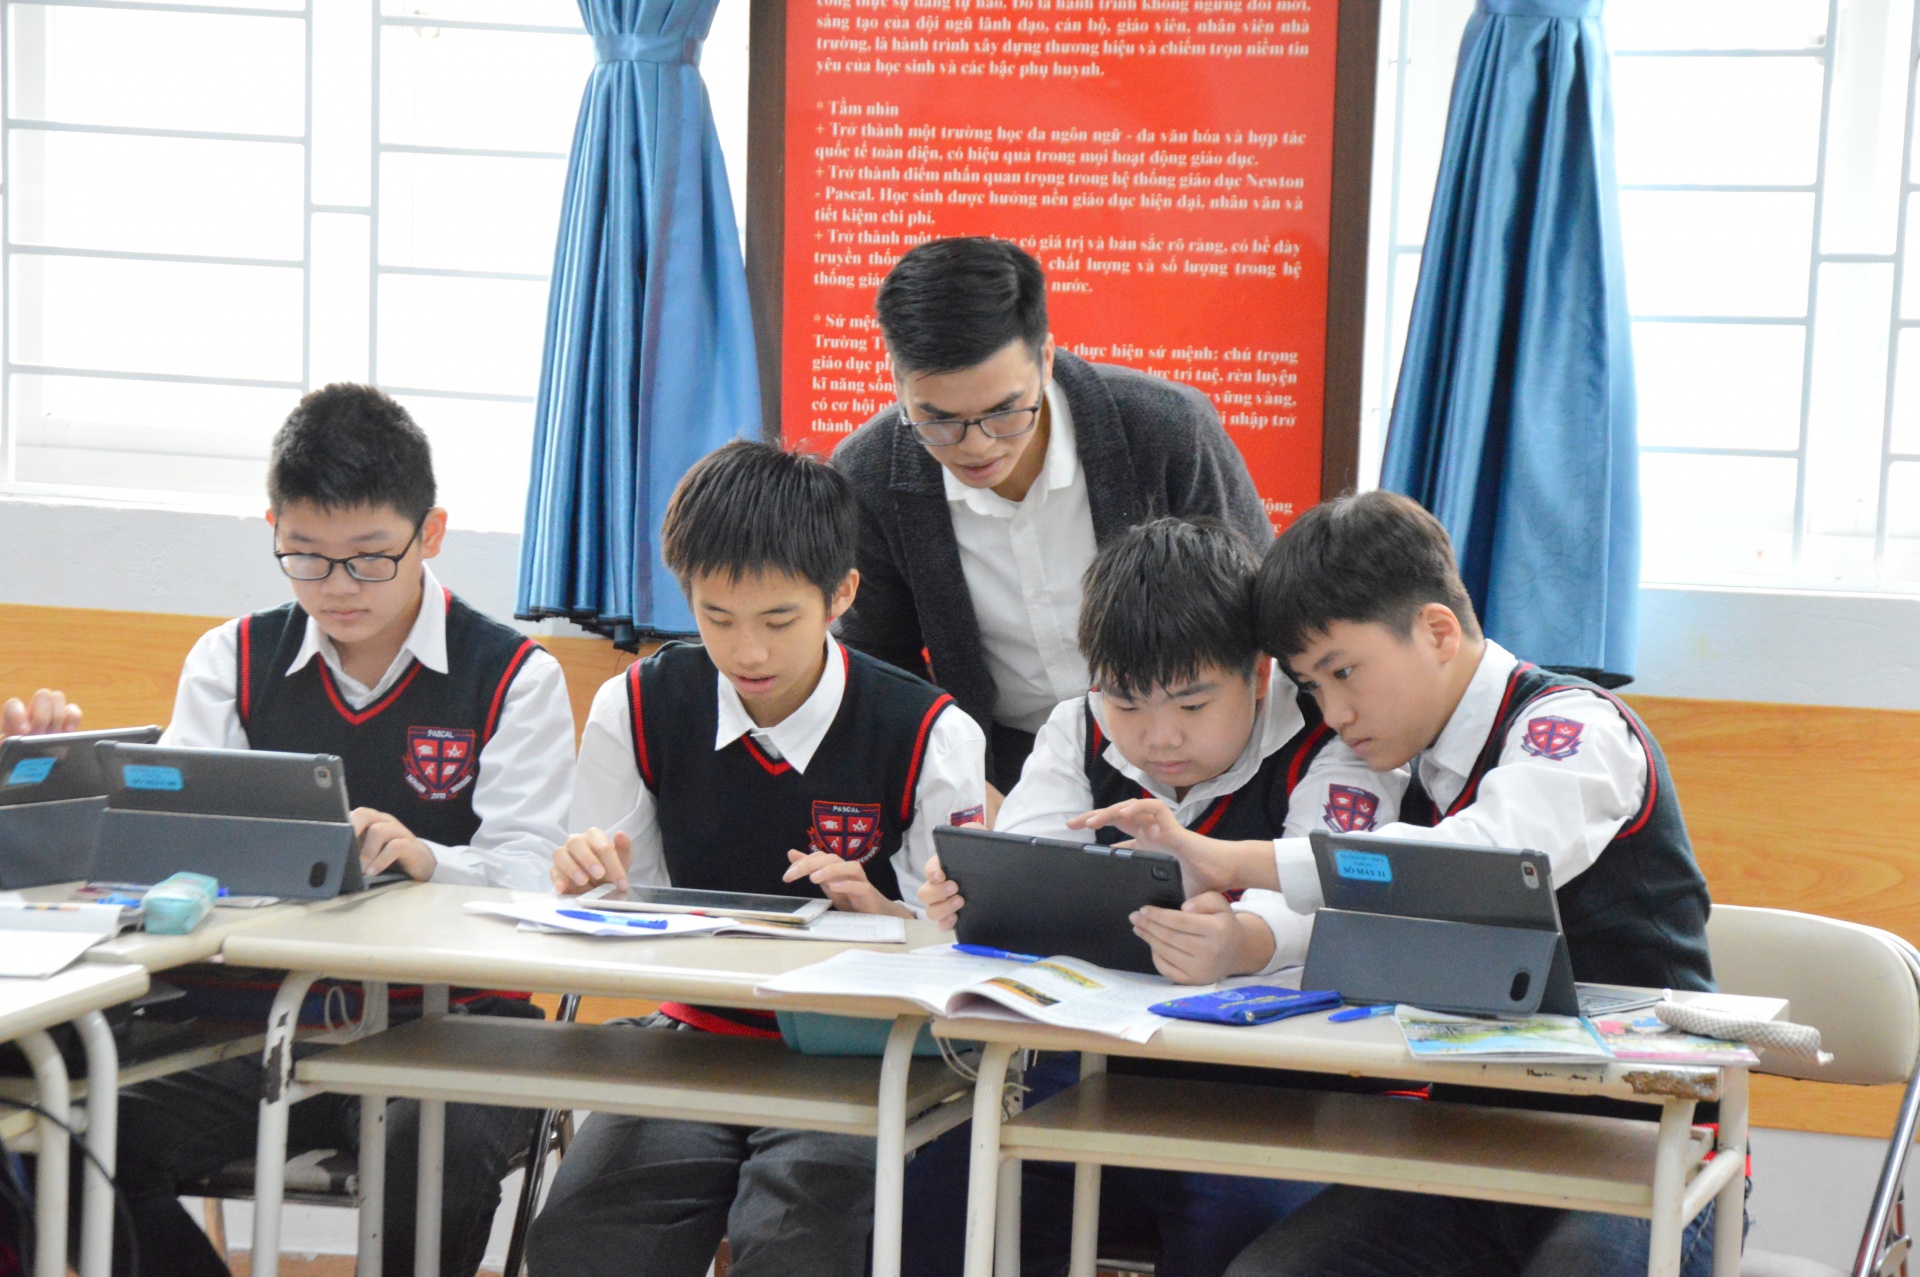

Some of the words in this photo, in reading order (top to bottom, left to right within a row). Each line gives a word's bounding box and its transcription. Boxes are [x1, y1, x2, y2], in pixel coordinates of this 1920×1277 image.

[816, 14, 850, 33] sáng
[856, 16, 879, 33] tạo
[916, 15, 939, 34] đội
[944, 15, 974, 35] ngũ
[978, 16, 1012, 31] lãnh
[1017, 16, 1050, 35] đạo,
[1054, 16, 1082, 32] cán
[1088, 17, 1110, 36] bộ,
[1116, 17, 1148, 36] giáo
[1154, 17, 1190, 35] viên,
[1196, 18, 1236, 33] nhân
[1242, 18, 1274, 34] viên
[1280, 19, 1310, 34] nhà
[816, 36, 872, 56] trường,
[874, 36, 888, 52] là
[892, 37, 928, 52] hành
[932, 37, 970, 53] trình
[974, 38, 998, 57] xây
[1002, 38, 1042, 57] dựng
[1045, 38, 1100, 58] thương
[1102, 39, 1134, 58] hiệu
[1138, 39, 1156, 55] và
[1160, 36, 1206, 55] chiếm
[1209, 41, 1242, 59] trọn
[1246, 37, 1284, 56] niềm
[1287, 42, 1308, 56] tin
[816, 57, 841, 76] yêu
[875, 58, 901, 77] học
[904, 58, 934, 74] sinh
[938, 59, 957, 74] và
[960, 59, 986, 75] các
[989, 60, 1014, 79] bậc
[1018, 60, 1048, 79] phụ
[1052, 61, 1104, 80] huynh.
[828, 97, 862, 116] Tầm
[861, 122, 904, 138] thành
[908, 123, 936, 142] một
[940, 123, 992, 143] trường
[997, 124, 1022, 143] học
[1050, 125, 1088, 144] ngôn
[1092, 126, 1122, 145] ngữ
[1160, 127, 1188, 142] văn
[1192, 127, 1220, 143] hóa
[1226, 128, 1242, 143] và
[1248, 128, 1278, 148] hợp
[1282, 129, 1306, 144] tác
[814, 140, 850, 163] quốc
[854, 140, 868, 159] tế
[872, 144, 904, 160] toàn
[906, 145, 944, 164] diện,
[947, 145, 964, 161] có
[968, 146, 999, 165] hiệu
[1036, 148, 1076, 166] trong
[1080, 149, 1108, 166] mọi
[1112, 148, 1146, 167] hoạt
[1149, 149, 1188, 168] động
[1190, 149, 1222, 169] giáo
[1226, 150, 1260, 169] dục.
[858, 165, 900, 180] thành
[943, 163, 980, 182] nhấn
[984, 172, 1020, 187] quan
[1024, 169, 1065, 187] trọng
[1068, 170, 1108, 188] trong
[1112, 169, 1130, 188] hệ
[1132, 166, 1176, 189] thống
[1179, 171, 1211, 190] giáo
[1214, 171, 1242, 190] dục
[1246, 172, 1304, 187] Newton
[880, 187, 908, 206] Học
[912, 188, 944, 203] sinh
[948, 188, 985, 207] được
[1041, 186, 1068, 205] nền
[1072, 191, 1104, 210] giáo
[1108, 191, 1136, 210] dục
[1140, 192, 1172, 211] hiện
[1176, 192, 1206, 211] đại,
[1210, 193, 1248, 209] nhân
[1252, 194, 1280, 209] văn
[1285, 194, 1303, 210] và
[814, 203, 838, 222] tiết
[842, 207, 878, 226] kiệm
[881, 208, 904, 224] chi
[908, 209, 936, 228] phí.
[858, 229, 900, 245] thành
[1020, 233, 1036, 248] có
[1039, 233, 1062, 253] giá
[1065, 235, 1084, 253] trị
[1087, 234, 1104, 250] và
[1140, 232, 1164, 251] sắc
[1168, 236, 1184, 252] rõ
[1188, 237, 1228, 256] ràng,
[1231, 237, 1248, 253] có
[1252, 234, 1270, 253] bề
[1274, 238, 1300, 258] dày
[814, 246, 862, 269] truyền
[1048, 252, 1080, 271] chất
[1086, 256, 1130, 276] lượng
[1136, 257, 1154, 272] và
[1161, 254, 1178, 273] số
[1184, 258, 1228, 278] lượng
[1234, 261, 1276, 279] trong
[1283, 260, 1302, 279] hệ
[814, 267, 854, 290] thống
[1052, 276, 1093, 292] nước.
[825, 313, 846, 329] Sứ
[813, 335, 868, 354] Trường
[1074, 342, 1106, 361] thực
[1112, 343, 1143, 362] hiện
[1148, 344, 1166, 359] sứ
[1171, 345, 1218, 364] mệnh:
[1222, 346, 1252, 361] chú
[1256, 348, 1298, 366] trọng
[812, 355, 842, 374] giáo
[845, 355, 871, 374] dục
[812, 376, 828, 392] kĩ
[830, 377, 865, 396] năng
[1174, 365, 1192, 380] trí
[1196, 365, 1224, 384] tuệ,
[1227, 366, 1252, 382] rèn
[1256, 367, 1298, 387] luyện
[812, 396, 828, 412] có
[832, 401, 849, 412] cơ
[852, 397, 875, 416] hội
[1214, 389, 1252, 408] vững
[1256, 390, 1296, 409] vàng,
[811, 418, 853, 433] thành
[1230, 409, 1268, 429] nhập
[427, 729, 454, 739] PASCAL
[832, 805, 860, 813] PASCAL
